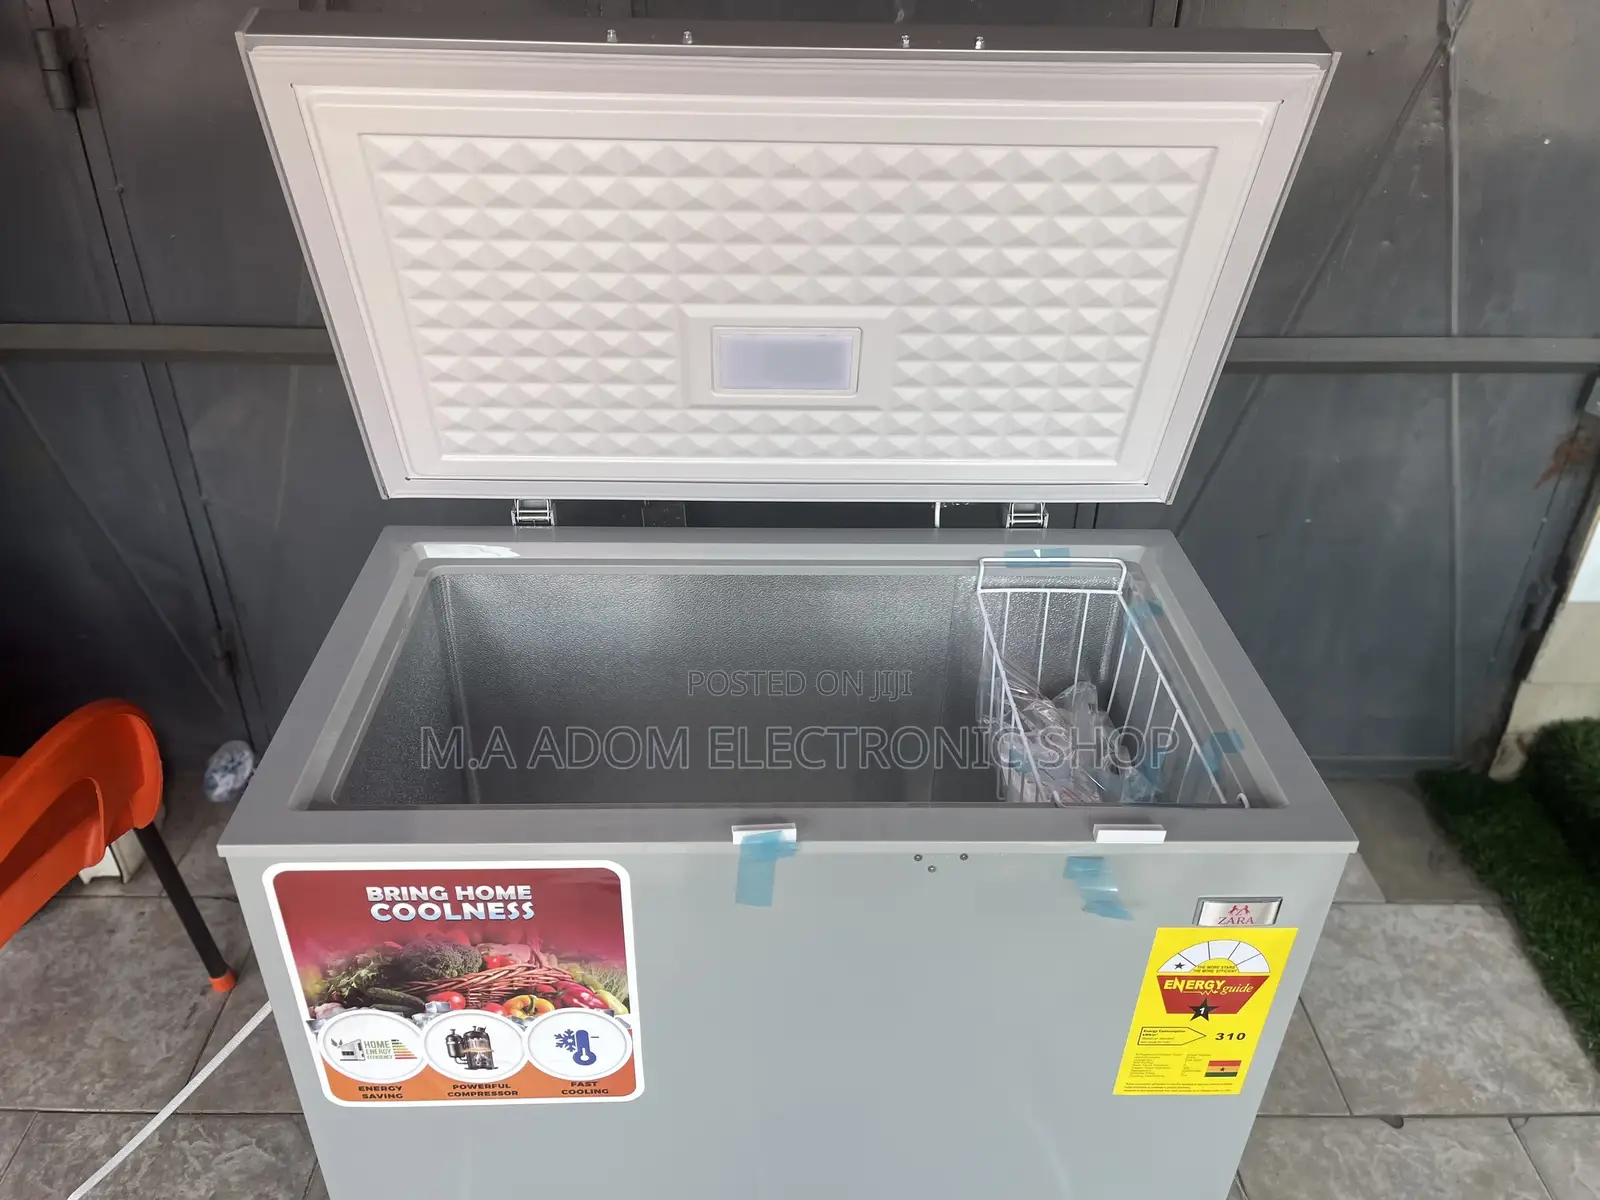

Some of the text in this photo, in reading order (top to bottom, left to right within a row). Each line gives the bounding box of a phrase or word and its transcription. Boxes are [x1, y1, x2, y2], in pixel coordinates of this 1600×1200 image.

[366, 885, 532, 901] BRING HOME
[370, 901, 535, 921] COOLNESS
[1218, 916, 1254, 925] ZARA
[1164, 977, 1254, 995] ENERGY guide
[1215, 1032, 1246, 1041] 310
[364, 1040, 391, 1049] HOME
